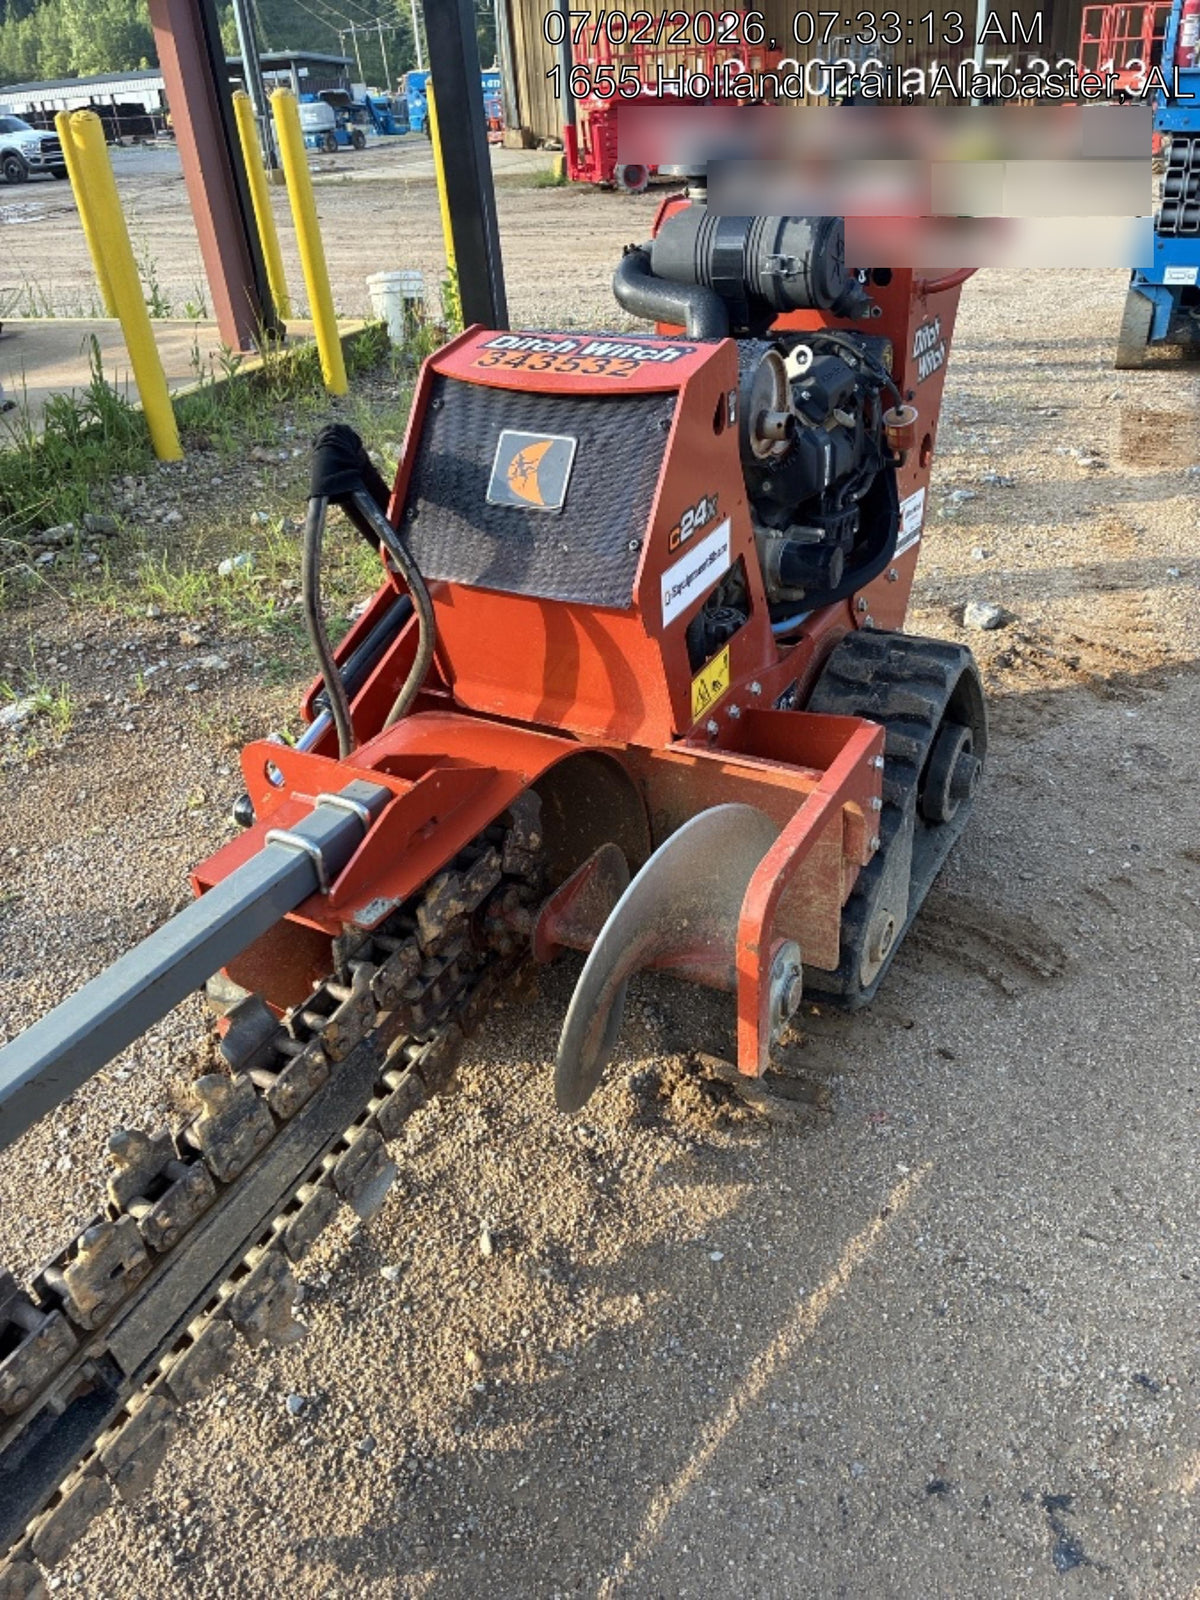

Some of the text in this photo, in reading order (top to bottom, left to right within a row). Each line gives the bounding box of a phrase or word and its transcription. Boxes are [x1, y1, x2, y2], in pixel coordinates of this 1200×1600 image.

[483, 335, 684, 363] Ditch Witch
[477, 351, 642, 377] 343532
